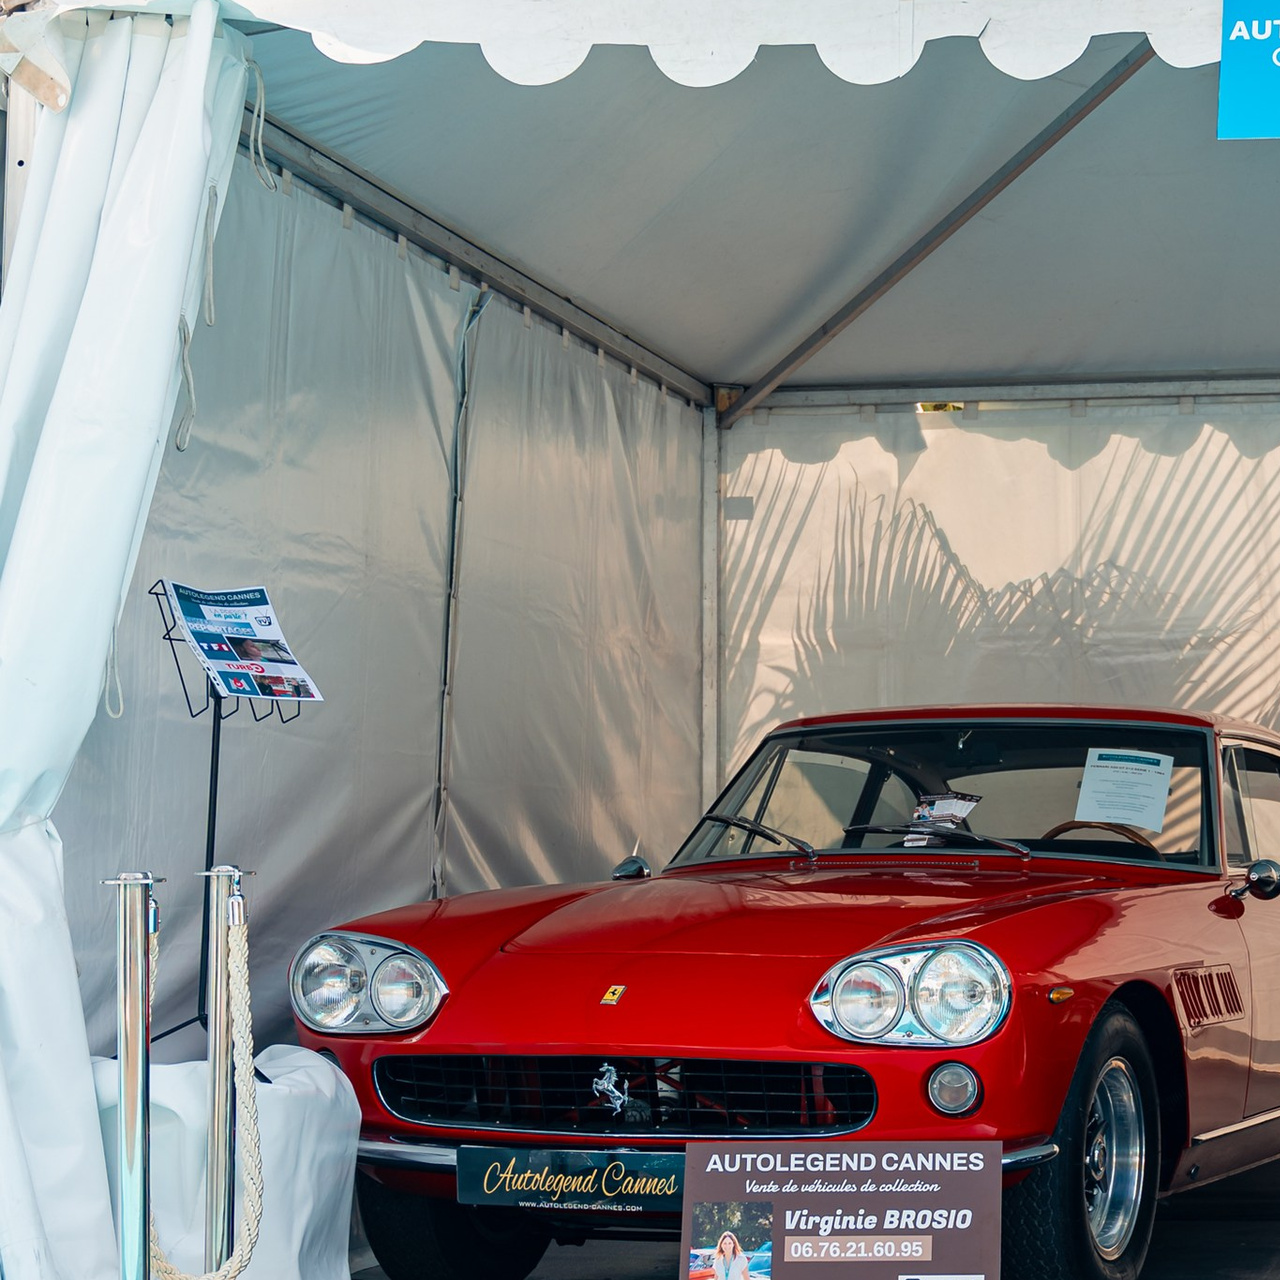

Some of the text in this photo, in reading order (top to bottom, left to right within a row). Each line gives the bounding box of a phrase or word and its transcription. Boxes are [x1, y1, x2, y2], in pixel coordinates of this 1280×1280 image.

[179, 588, 261, 601] AUTOLEGEND CANNES
[199, 642, 229, 652] TF1
[705, 1152, 985, 1173] AUTOLEGEND CANNES
[483, 1156, 678, 1201] Autolegend Cannes
[745, 1178, 941, 1193] Vente de véhicules de collection
[784, 1209, 973, 1236] Virginie BROSIO
[790, 1240, 923, 1259] 06.76.21.60.95
